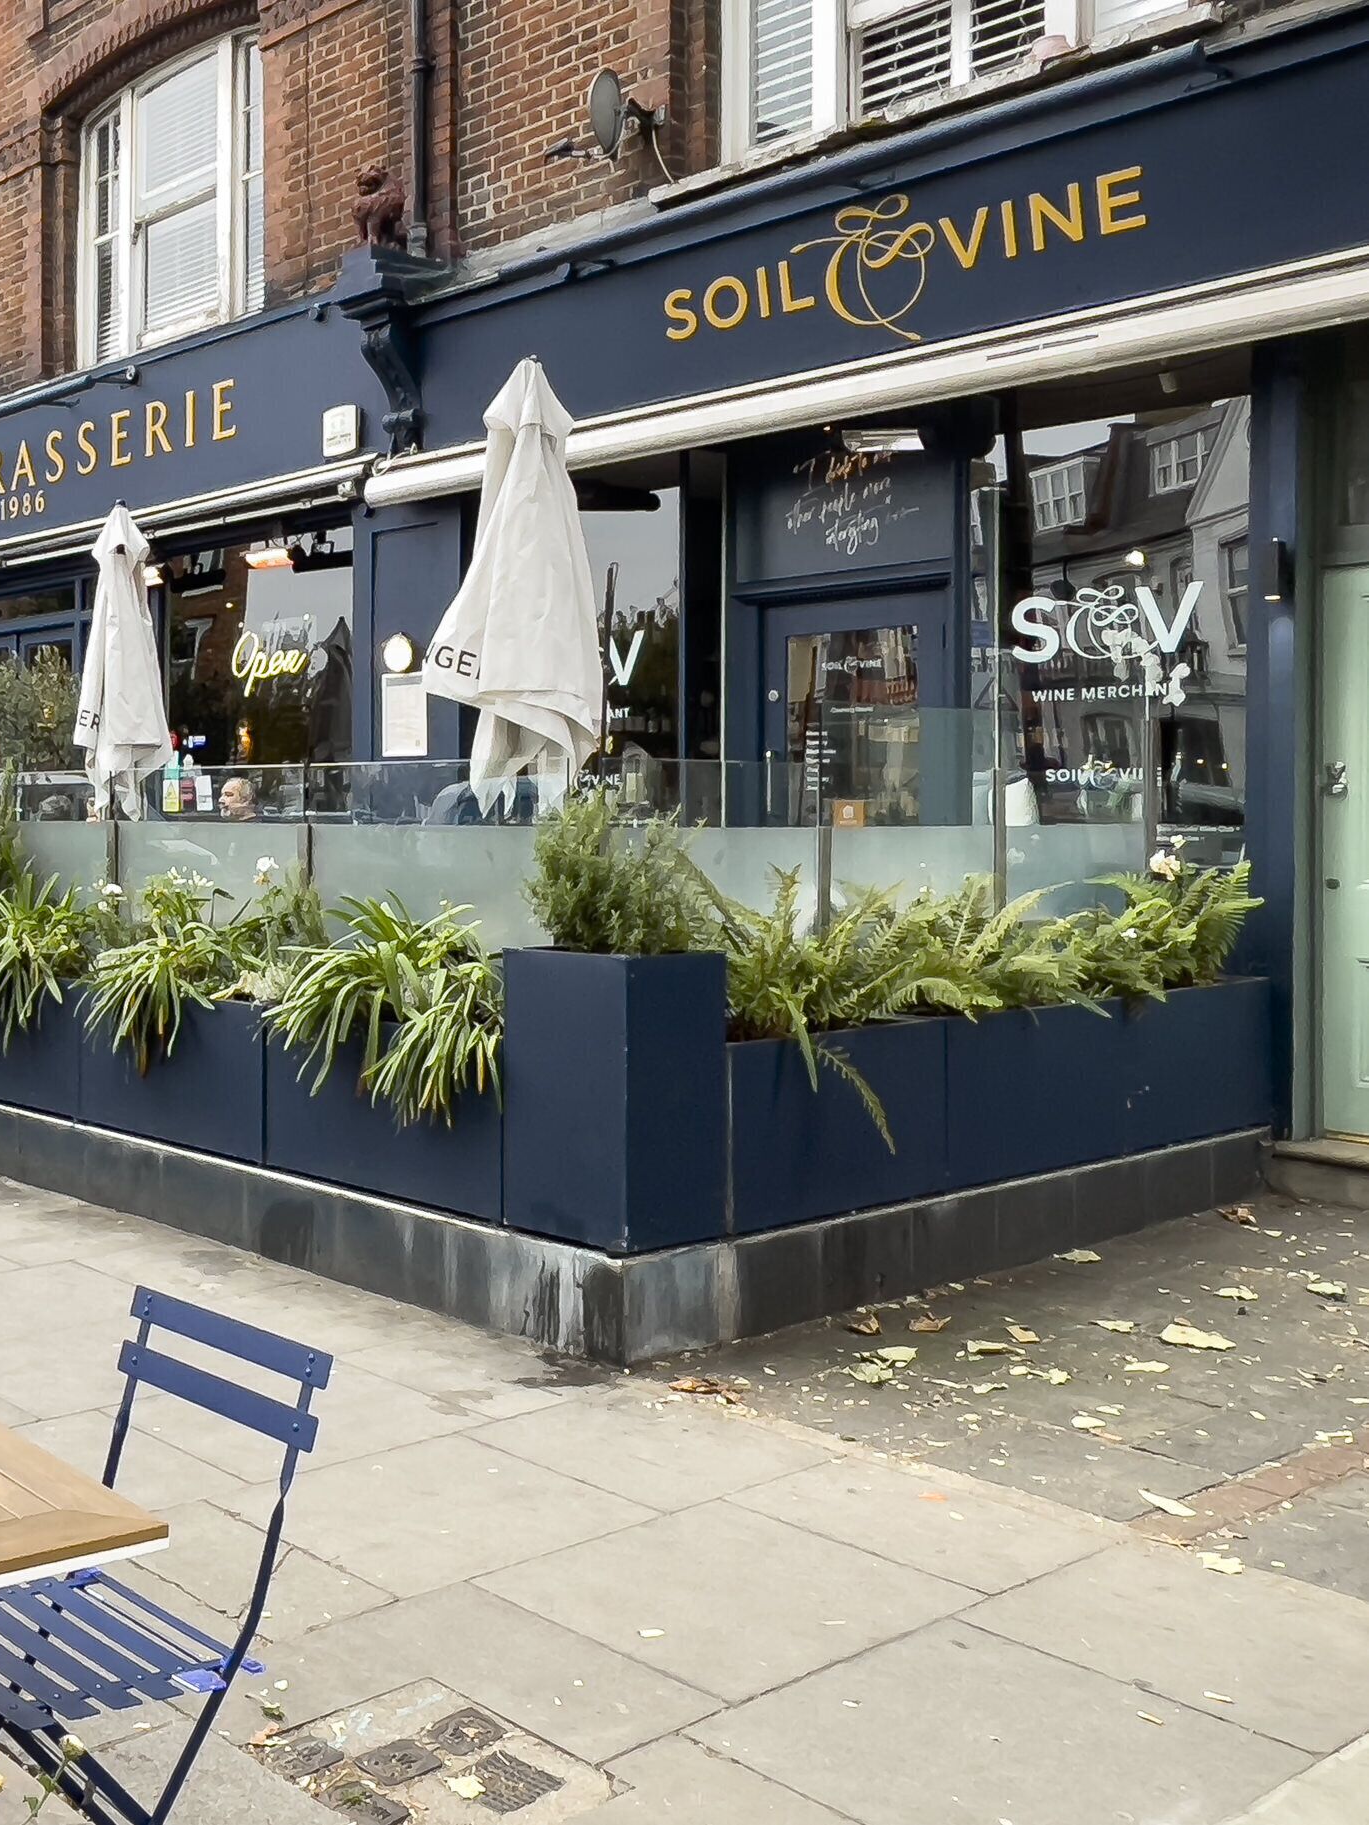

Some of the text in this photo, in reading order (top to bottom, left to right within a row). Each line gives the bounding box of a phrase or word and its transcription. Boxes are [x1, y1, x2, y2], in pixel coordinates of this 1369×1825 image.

[663, 260, 816, 341] SOIL
[938, 165, 1148, 270] VINE
[231, 630, 307, 698] Open
[1031, 683, 1168, 703] WINE MERCHN
[592, 773, 623, 786] VNE
